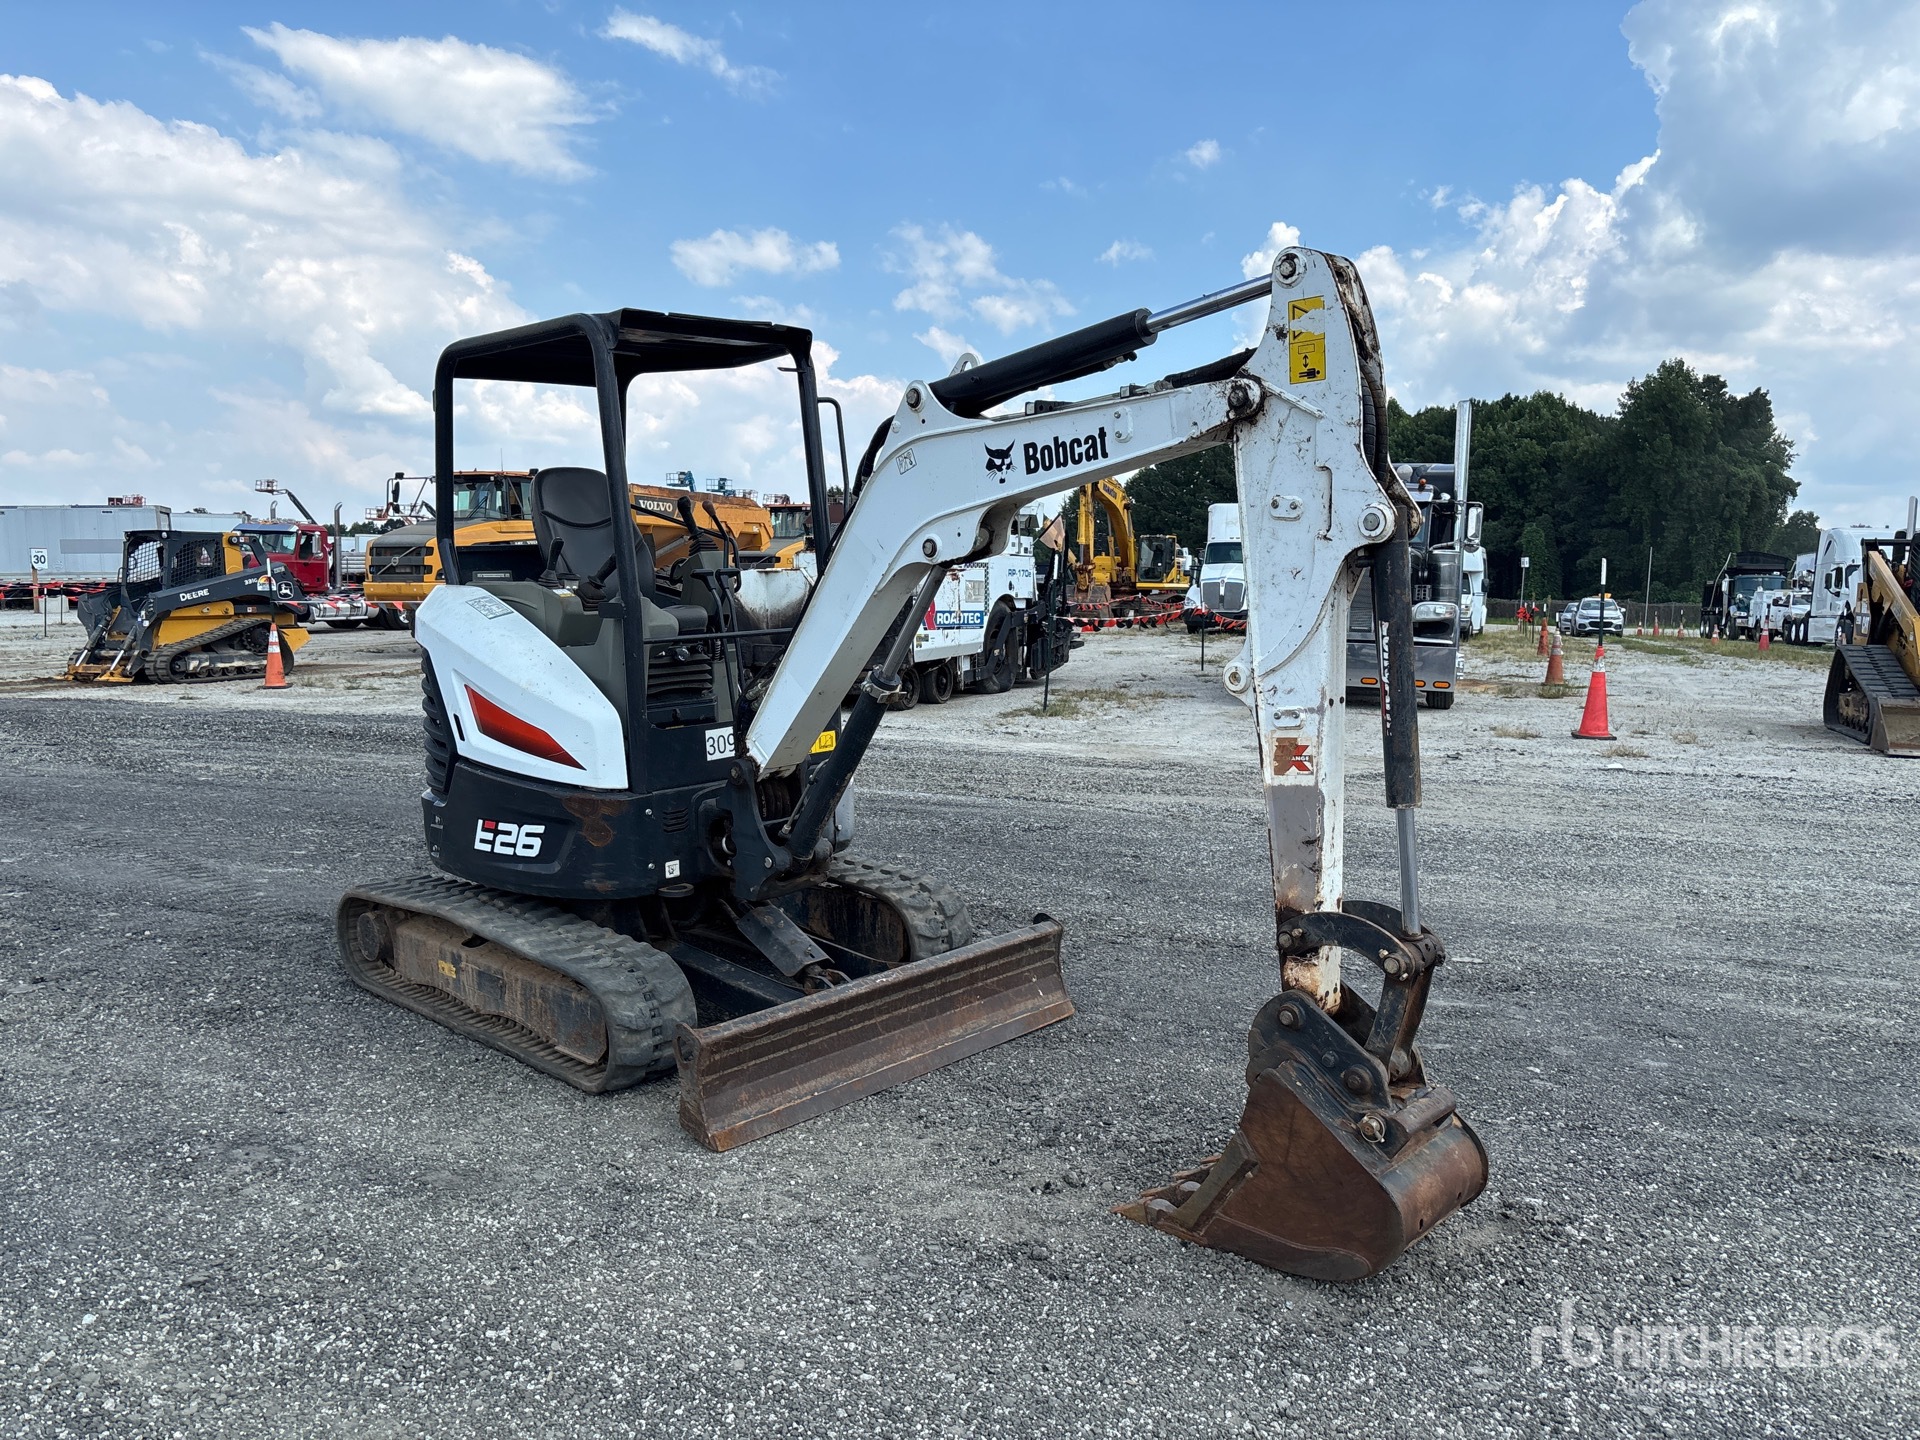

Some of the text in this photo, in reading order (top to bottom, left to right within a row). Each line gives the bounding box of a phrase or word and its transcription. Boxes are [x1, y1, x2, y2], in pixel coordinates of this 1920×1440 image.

[1023, 426, 1109, 475] Bobcat
[639, 499, 673, 512] VOLVO
[33, 554, 46, 565] 30
[179, 588, 210, 602] DEERE
[474, 818, 546, 858] E26
